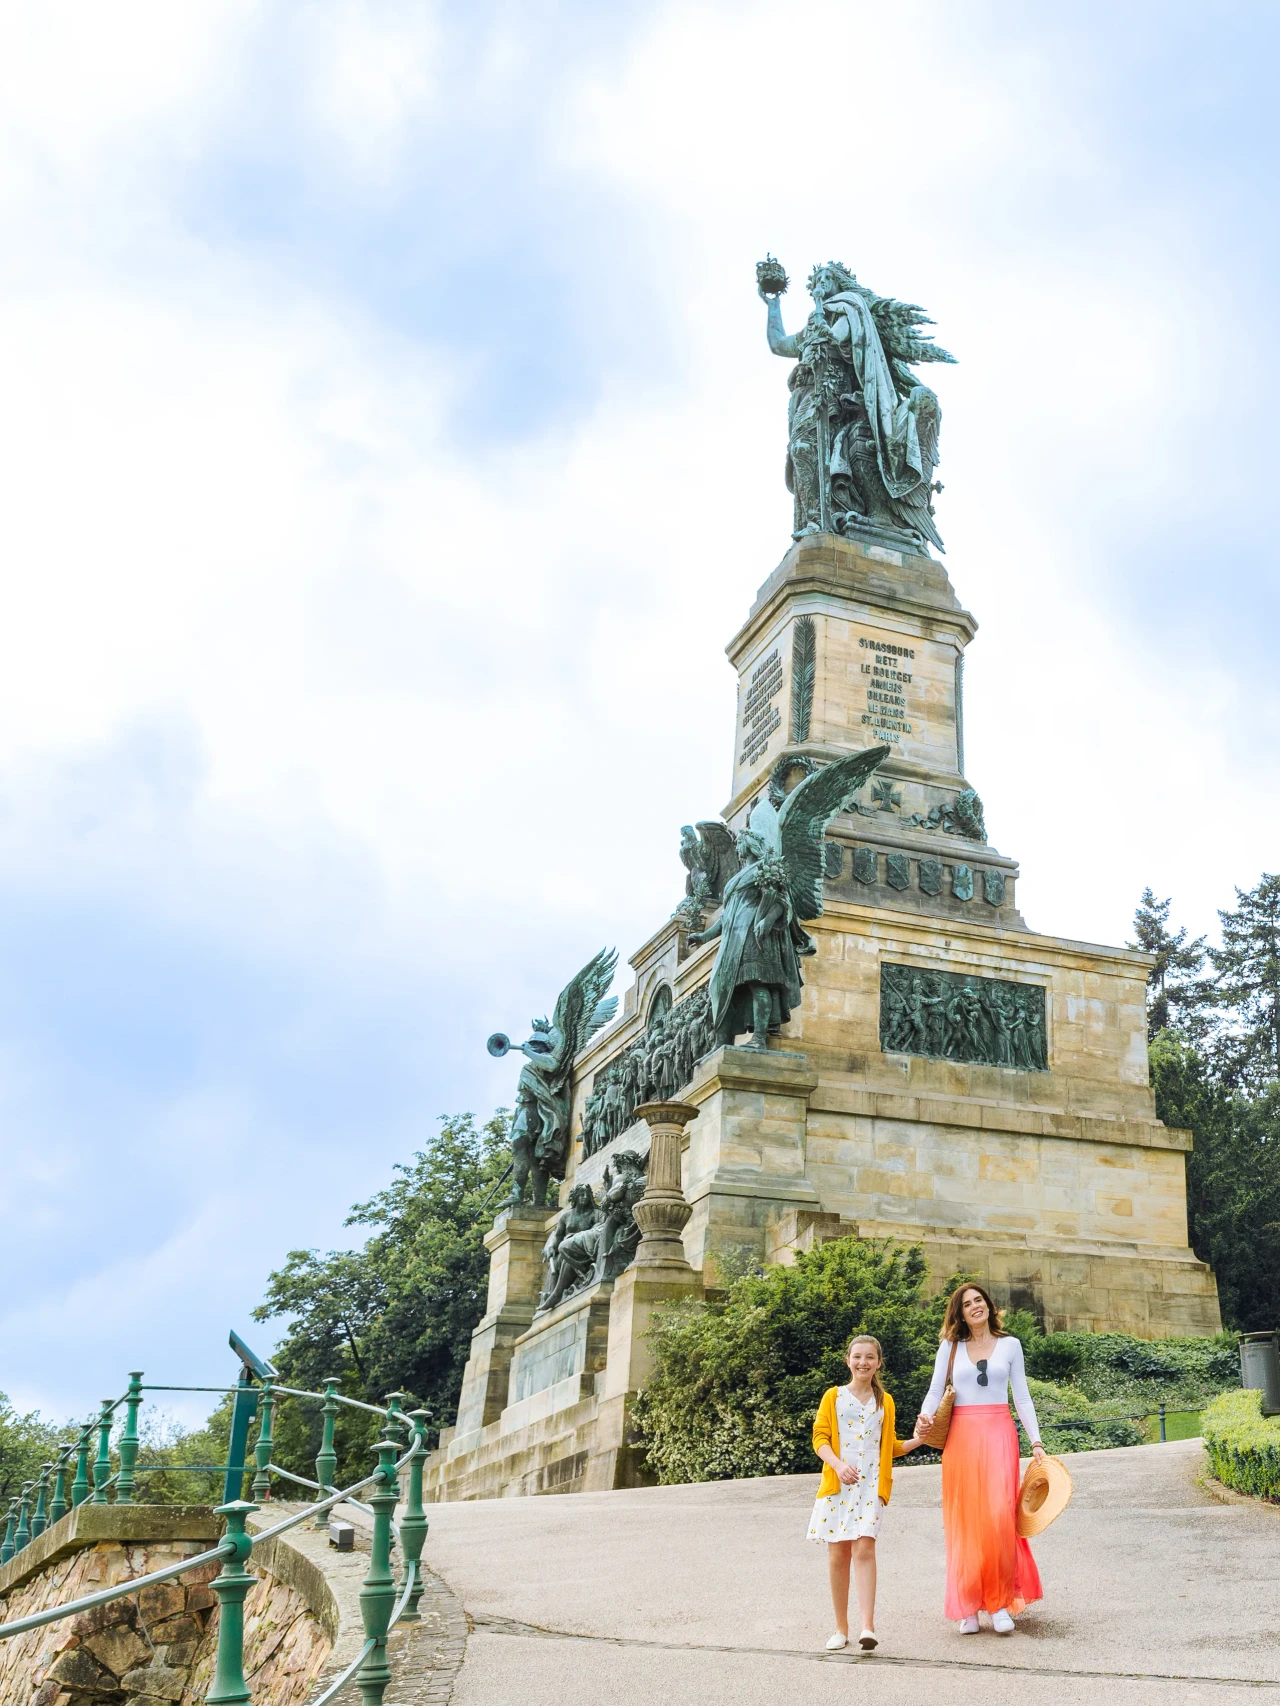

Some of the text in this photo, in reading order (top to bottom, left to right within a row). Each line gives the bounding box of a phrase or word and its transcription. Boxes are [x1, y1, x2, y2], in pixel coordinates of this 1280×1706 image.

[859, 638, 915, 659] STRASSBURG
[876, 654, 898, 668] METZ
[861, 664, 912, 683] LE BOURGET
[870, 678, 903, 694] AMIENS
[880, 705, 905, 719] MANS
[873, 728, 900, 743] PARIS
